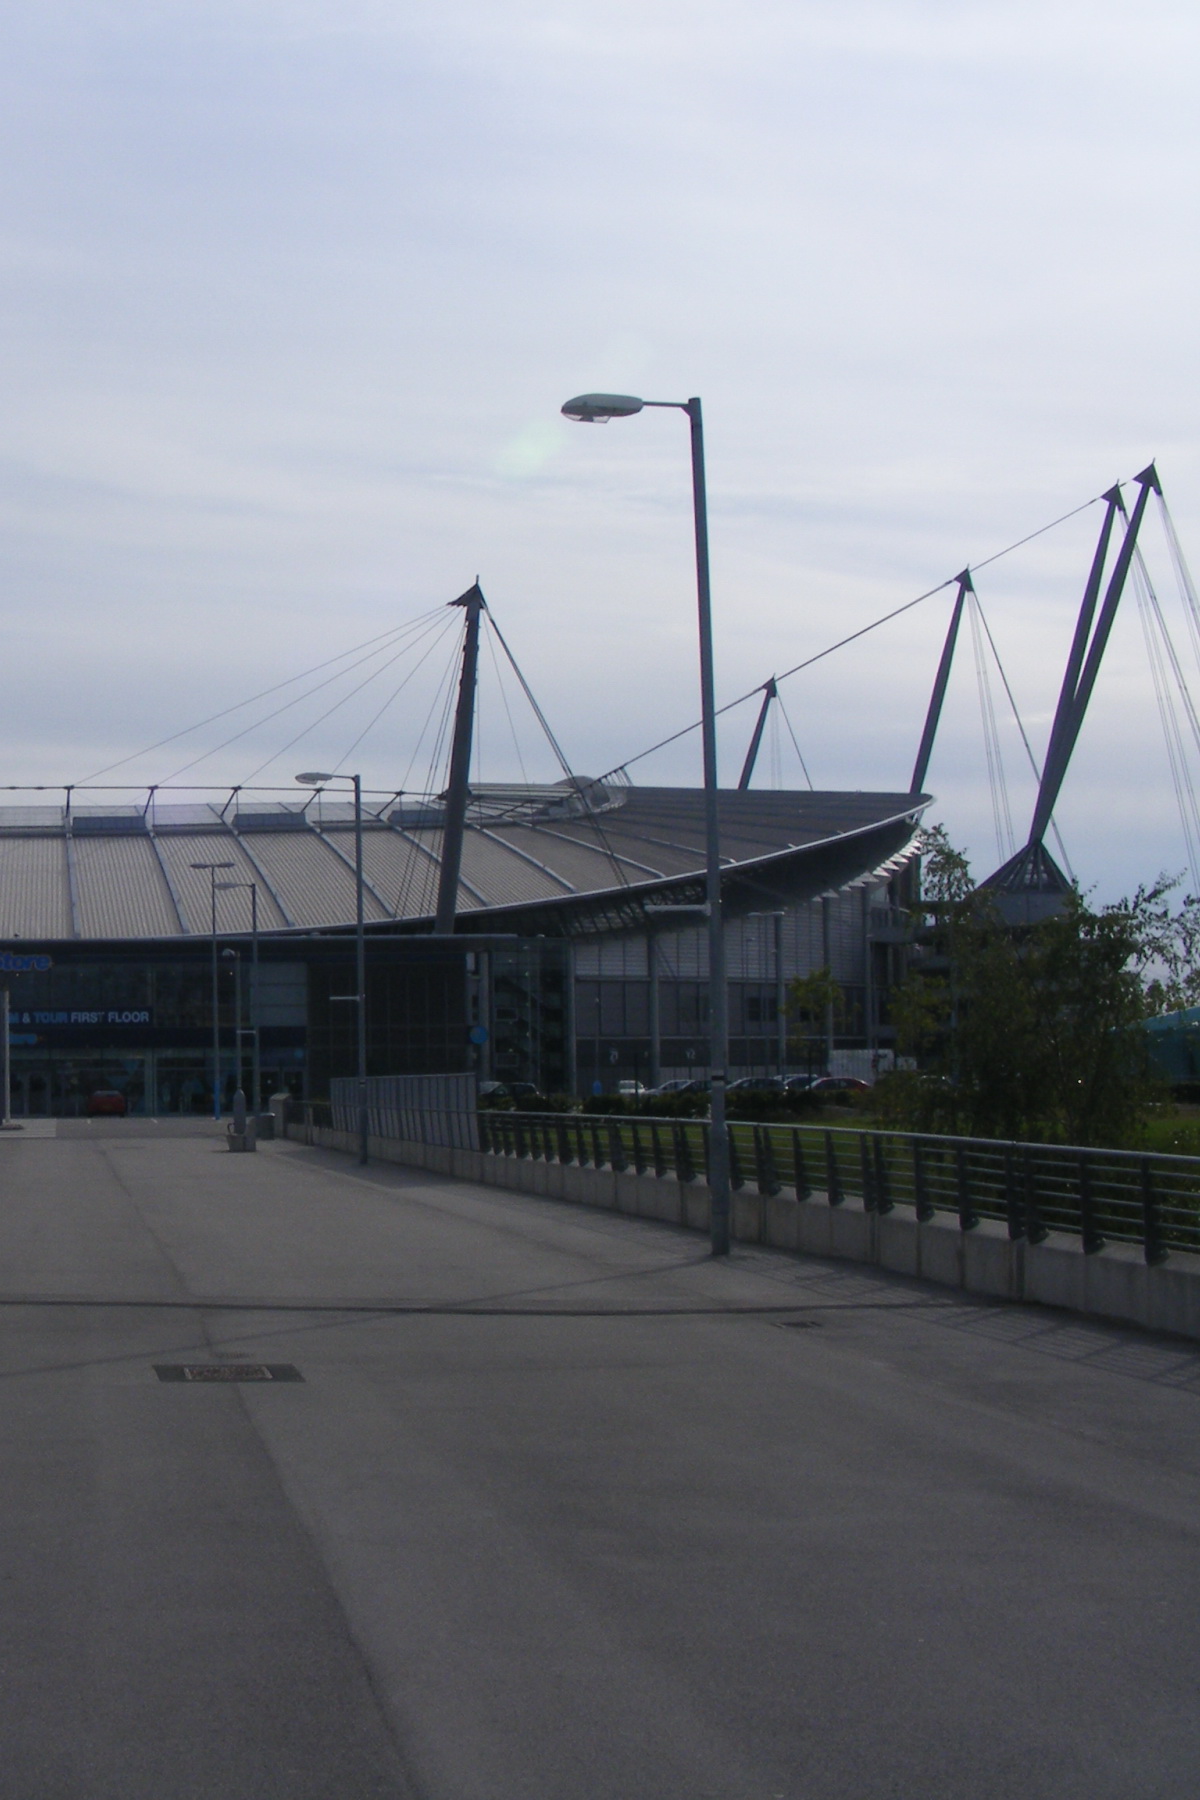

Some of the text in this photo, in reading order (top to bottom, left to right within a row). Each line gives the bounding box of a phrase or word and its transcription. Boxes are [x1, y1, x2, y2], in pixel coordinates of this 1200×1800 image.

[22, 1011, 31, 1023] &
[33, 1012, 68, 1023] TOUR
[71, 1011, 105, 1023] FIRST
[108, 1011, 150, 1023] FLOOR
